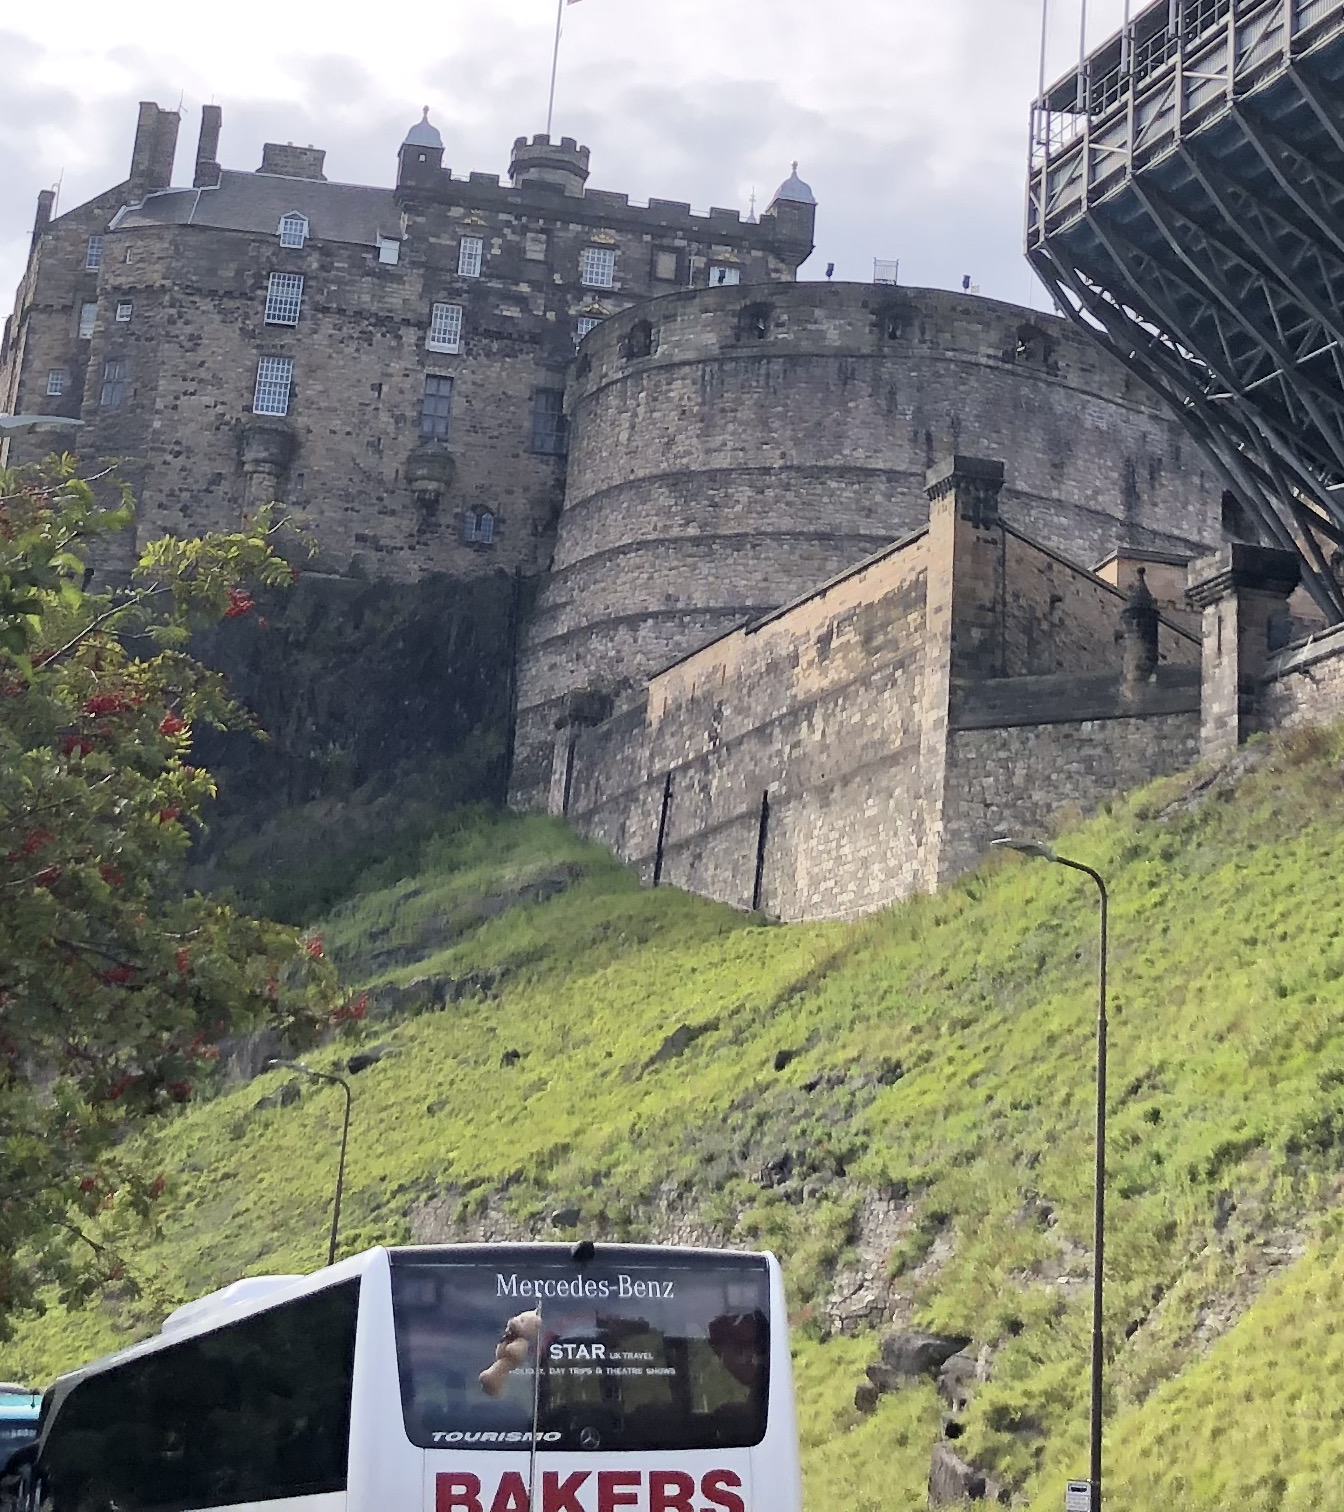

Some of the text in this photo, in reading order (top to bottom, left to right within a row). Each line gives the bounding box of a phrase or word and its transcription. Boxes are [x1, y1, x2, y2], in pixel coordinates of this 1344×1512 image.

[496, 1273, 674, 1299] Mercedes-Benz
[549, 1343, 606, 1360] STAR
[622, 1351, 654, 1360] TRAVEL
[606, 1367, 643, 1375] THEATRE
[432, 1431, 562, 1442] TOURISMO
[435, 1469, 746, 1512] BAKERS
